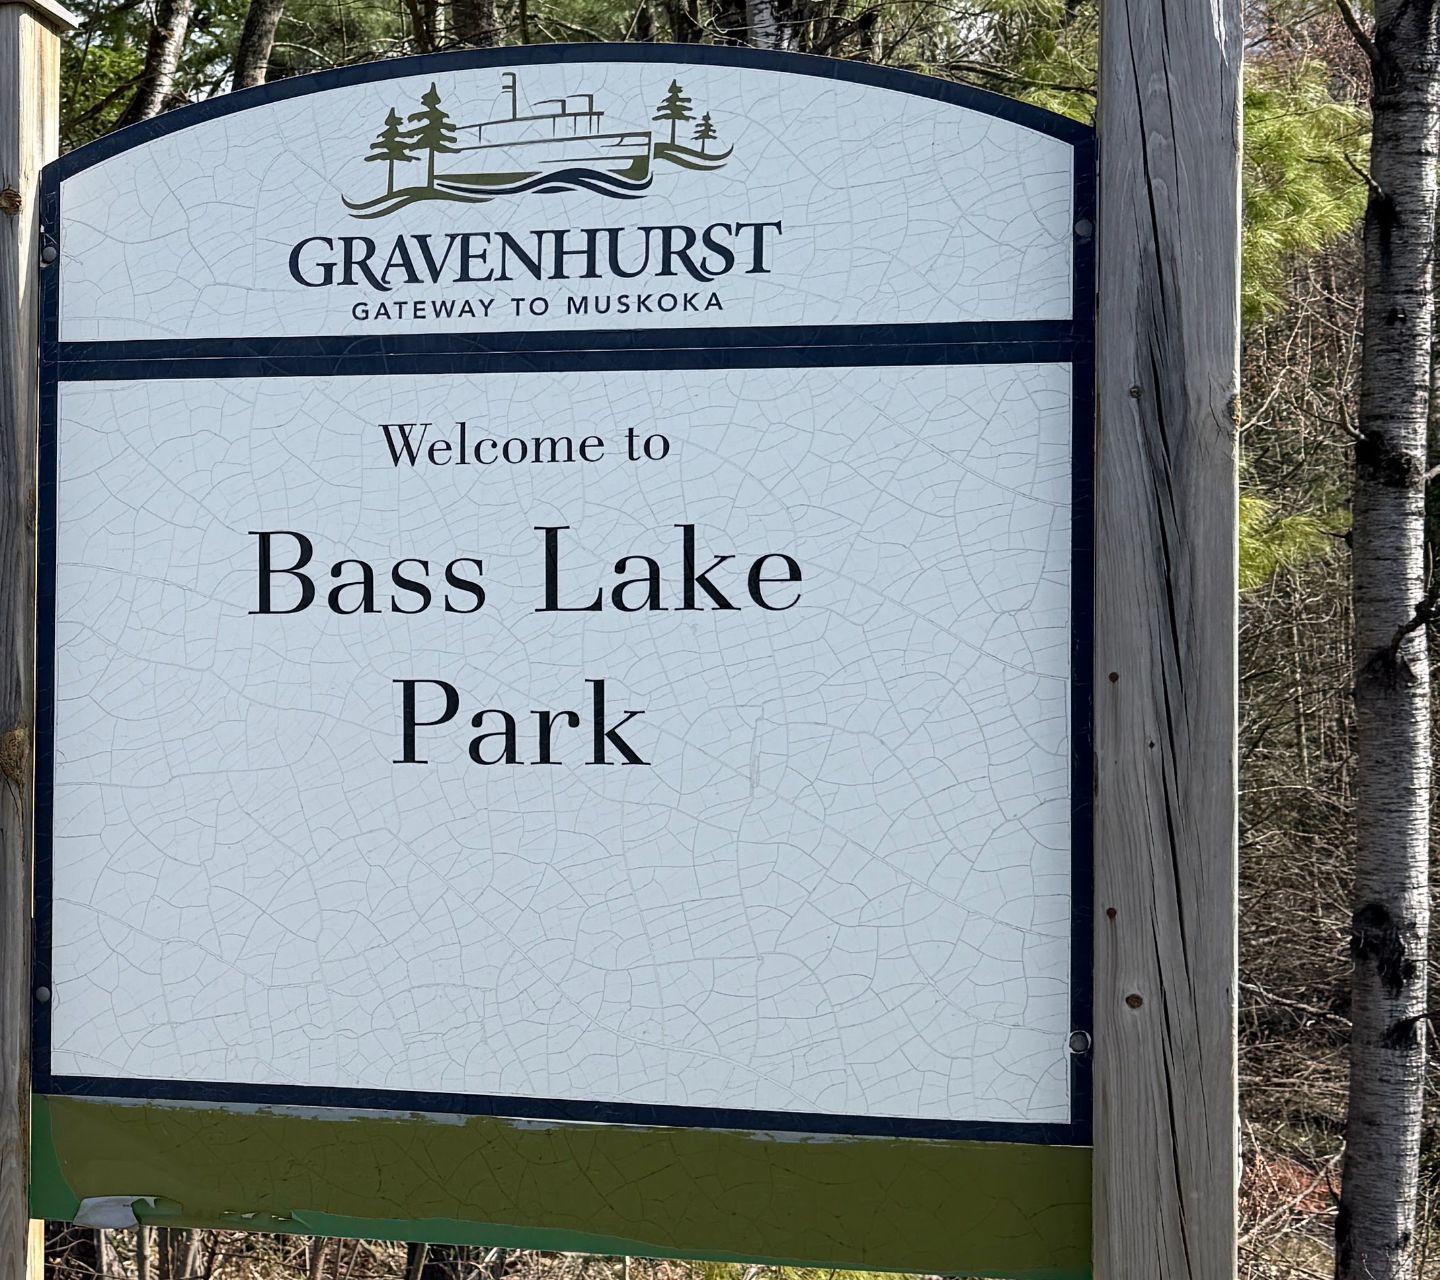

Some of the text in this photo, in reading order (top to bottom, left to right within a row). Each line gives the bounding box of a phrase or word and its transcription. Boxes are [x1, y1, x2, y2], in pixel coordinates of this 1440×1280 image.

[288, 219, 783, 292] GRAVENHURST
[351, 291, 724, 321] GATEWAY TO MUSKOKA
[378, 421, 671, 468] Welcome to
[248, 523, 803, 615] Bass Lake
[392, 678, 652, 766] Park
